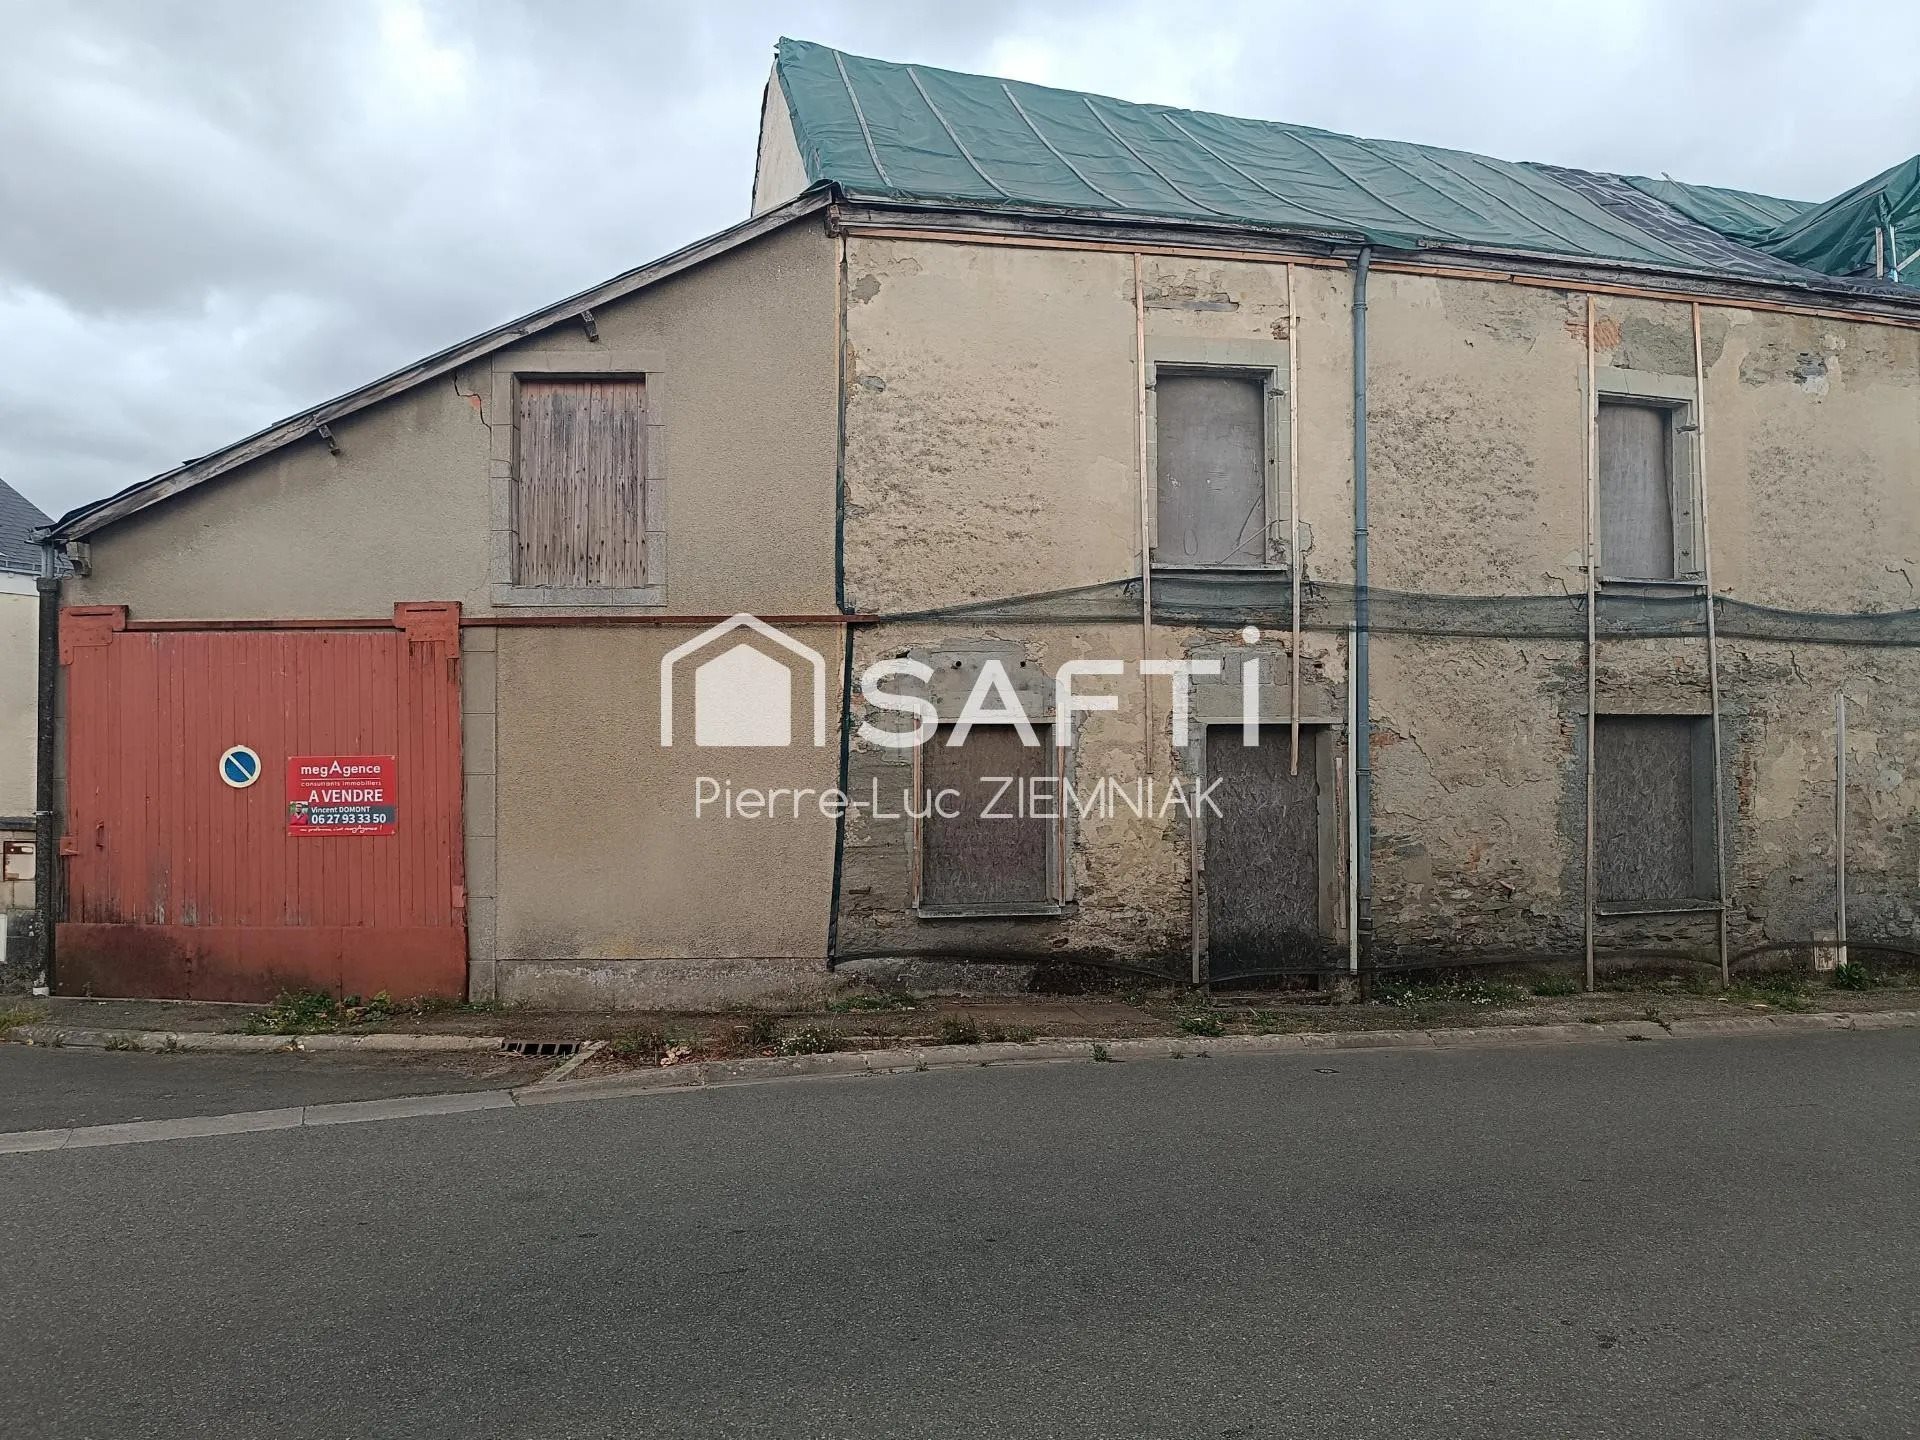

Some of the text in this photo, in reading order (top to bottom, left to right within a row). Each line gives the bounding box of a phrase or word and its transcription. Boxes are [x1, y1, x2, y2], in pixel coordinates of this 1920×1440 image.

[301, 760, 381, 777] megAgence
[309, 789, 383, 803] A VENDRE
[311, 814, 386, 824] 06 27 93 33 50
